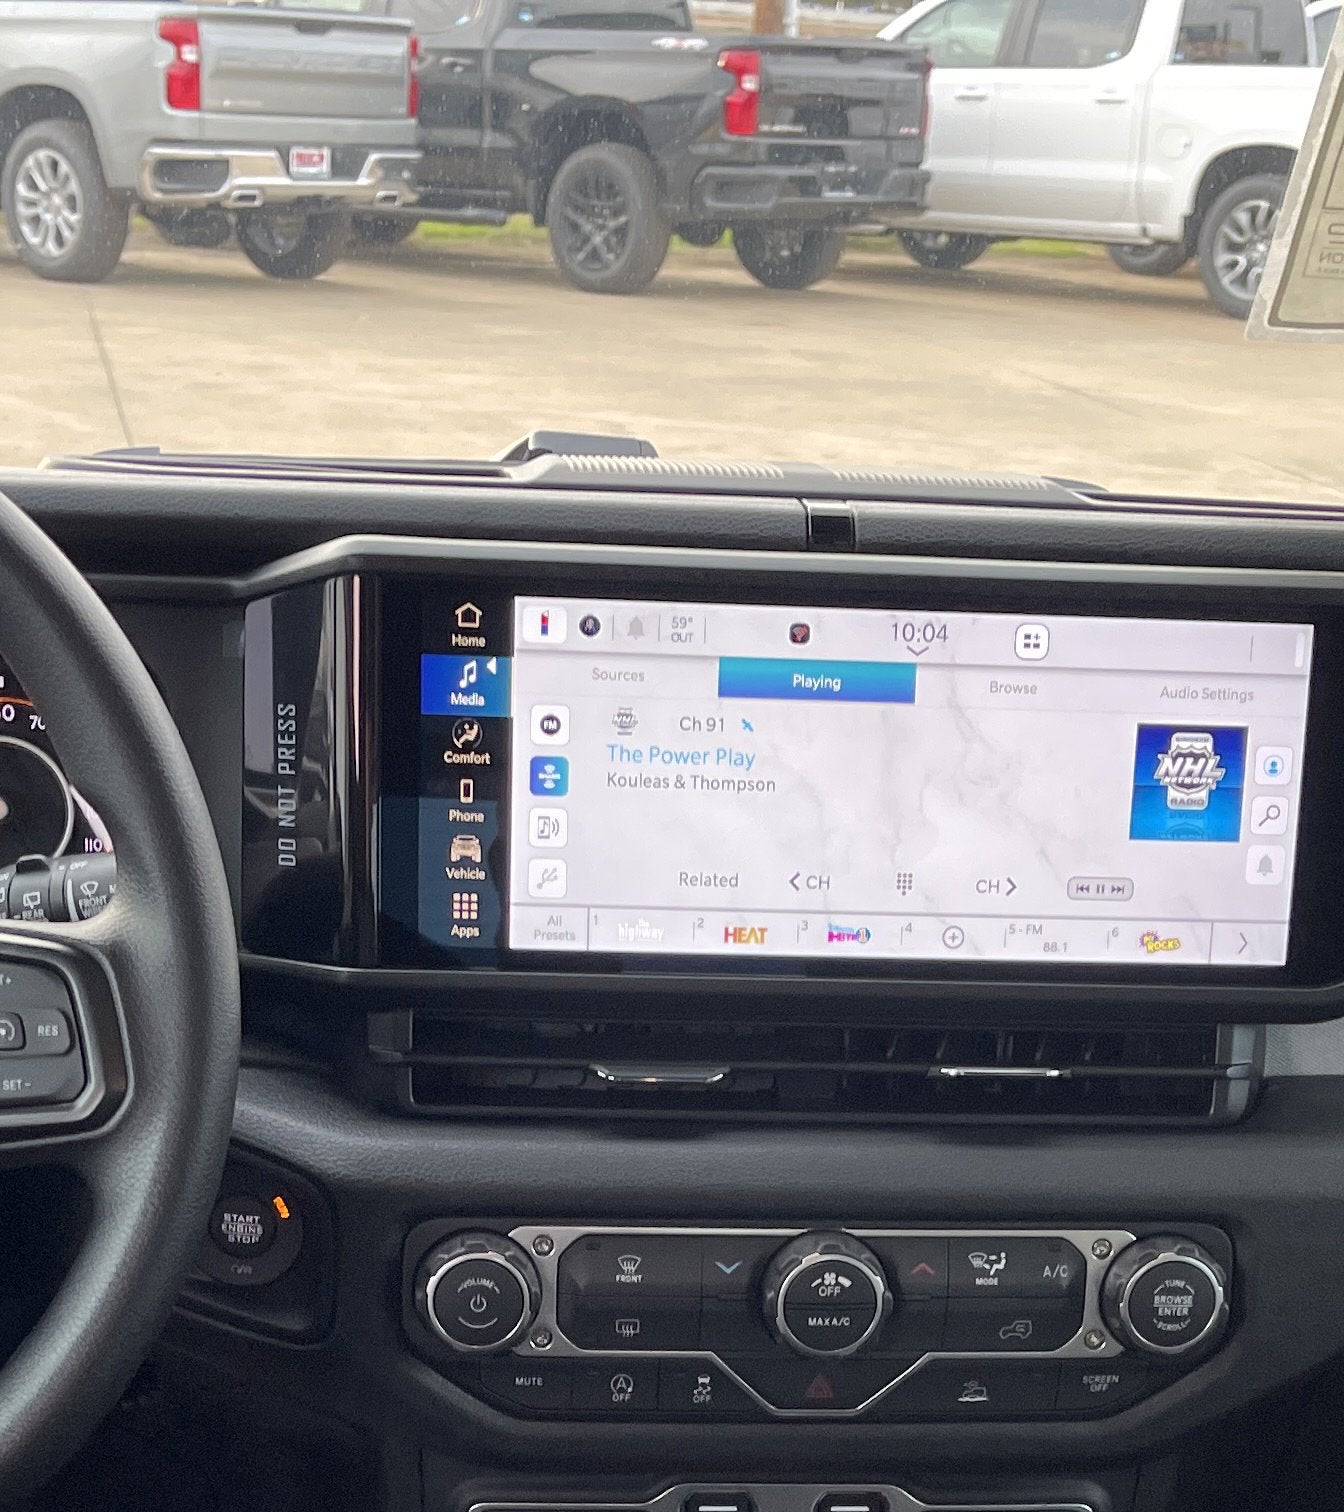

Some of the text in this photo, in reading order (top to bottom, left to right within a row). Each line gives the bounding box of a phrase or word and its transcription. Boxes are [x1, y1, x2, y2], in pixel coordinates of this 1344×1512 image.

[451, 632, 486, 648] Home
[670, 631, 694, 644] OUT
[890, 622, 949, 644] 10:04
[591, 667, 1255, 704] Sources Playing Browse Audio Settings
[450, 692, 485, 708] Media
[678, 715, 725, 733] Ch 91
[443, 749, 491, 766] Comfort
[607, 743, 757, 770] The Power Play
[1157, 756, 1223, 778] NHL
[277, 702, 297, 867] DO NOT PRESS
[606, 772, 776, 796] Kouleas & Thompson
[448, 807, 485, 824] Phone
[84, 837, 103, 853] 110
[445, 865, 486, 881] Vehicle
[678, 871, 1001, 895] Related CH CH
[547, 914, 563, 927] All
[451, 923, 480, 941] Apps
[534, 928, 576, 942] Presets
[723, 927, 768, 944] HEAT
[1025, 924, 1043, 935] FM
[37, 1024, 59, 1038] RES
[223, 1212, 261, 1223] START
[615, 1273, 643, 1283] FRONT
[1042, 1265, 1068, 1279] A/C
[463, 1277, 495, 1290] VOLUME
[975, 1277, 999, 1286] MODE
[818, 1286, 841, 1297] OFF
[1158, 1307, 1189, 1317] ENTER
[808, 1316, 851, 1326] MAX A/C
[515, 1376, 543, 1387] MUTE
[1082, 1374, 1120, 1385] SCREEN
[1089, 1382, 1110, 1393] OFF
[612, 1392, 631, 1402] OFF
[693, 1394, 712, 1404] OFF
